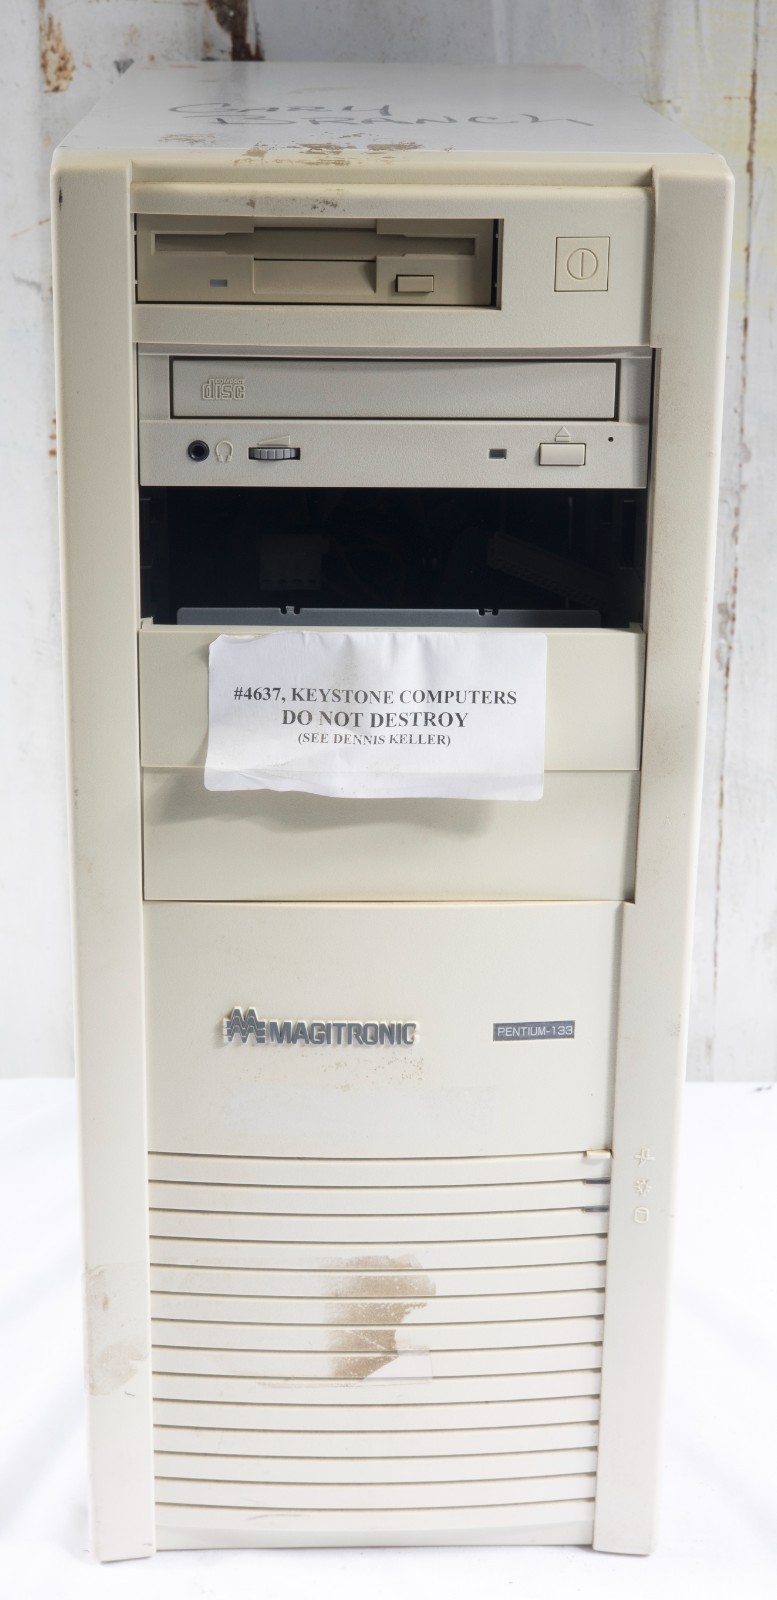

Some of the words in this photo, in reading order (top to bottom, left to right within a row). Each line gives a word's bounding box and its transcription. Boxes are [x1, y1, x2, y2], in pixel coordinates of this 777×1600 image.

[183, 114, 594, 126] BRANCH
[202, 379, 246, 400] disc
[233, 687, 286, 703] #4637,
[291, 688, 394, 704] KEYSTONE
[399, 690, 517, 705] COMPUTERS
[281, 710, 313, 726] DO
[319, 711, 364, 728] NOT
[370, 711, 469, 728] DESTROY
[298, 732, 329, 745] (SEE
[333, 733, 386, 746] DENNIS
[389, 734, 451, 746] KELLER)
[269, 1020, 418, 1046] MAGITRONIC
[497, 1025, 573, 1037] PENTIUM-133
